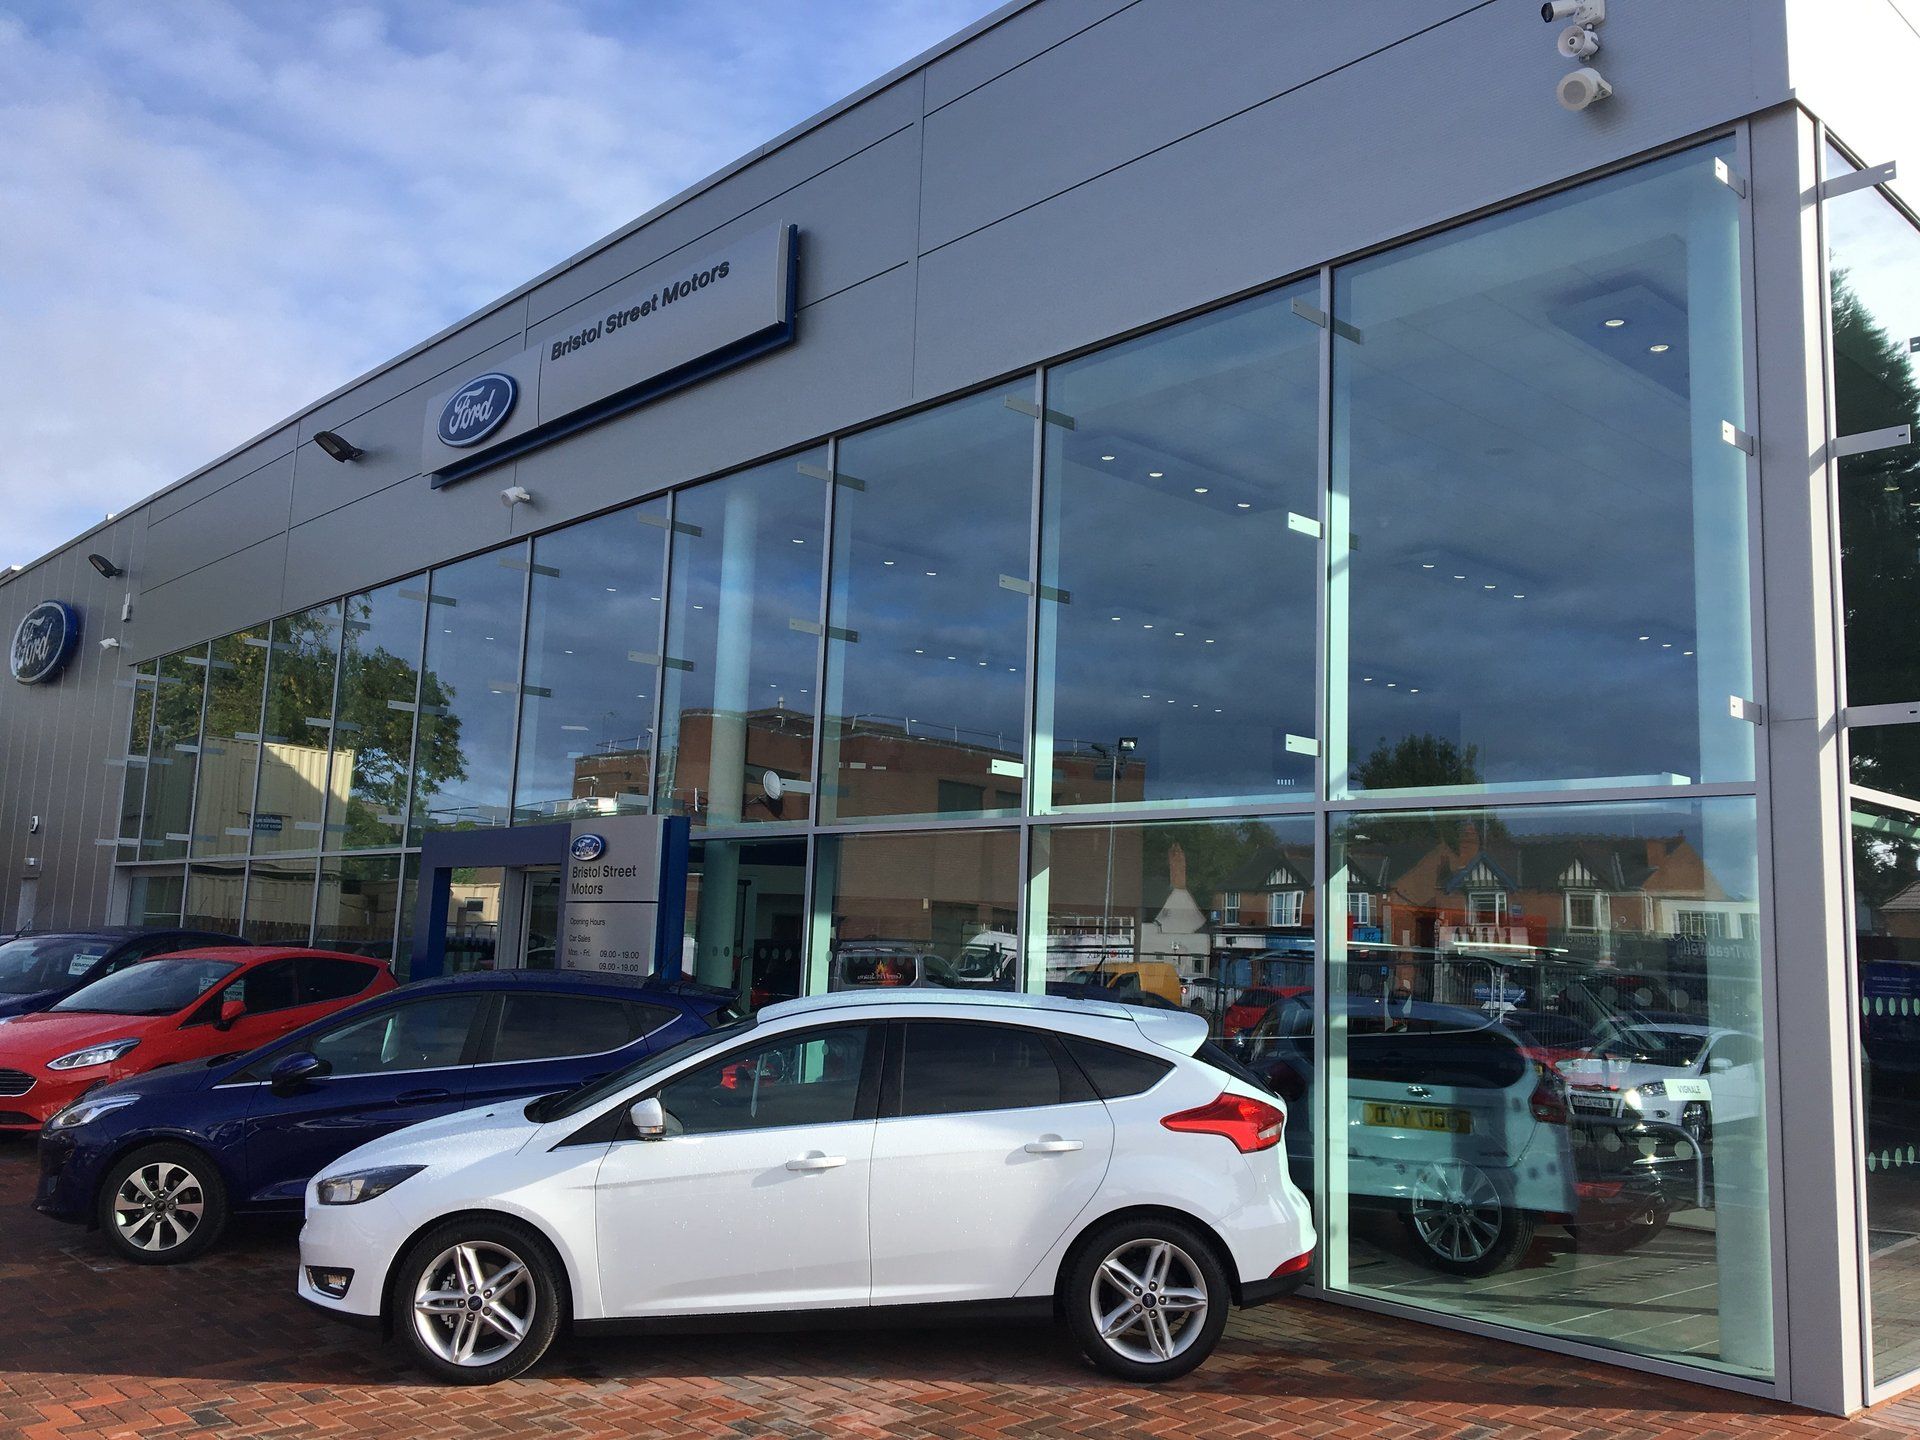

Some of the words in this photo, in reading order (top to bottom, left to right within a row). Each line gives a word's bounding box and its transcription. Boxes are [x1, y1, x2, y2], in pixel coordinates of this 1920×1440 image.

[551, 320, 603, 361] Bristol
[605, 293, 658, 335] Street
[661, 260, 730, 308] Motors
[448, 385, 496, 435] Ford
[16, 615, 53, 669] Ford
[572, 866, 601, 879] Bristol
[602, 865, 637, 878] Street
[571, 883, 603, 895] Motors
[569, 917, 589, 928] Opening
[589, 917, 606, 926] Hours
[568, 934, 577, 942] Car
[578, 934, 591, 943] Sales
[599, 950, 617, 958] 09.00
[622, 951, 640, 959] 19.00
[598, 962, 616, 970] 09.00
[621, 964, 639, 972] 19.00
[1677, 1085, 1701, 1094] VIGNALE
